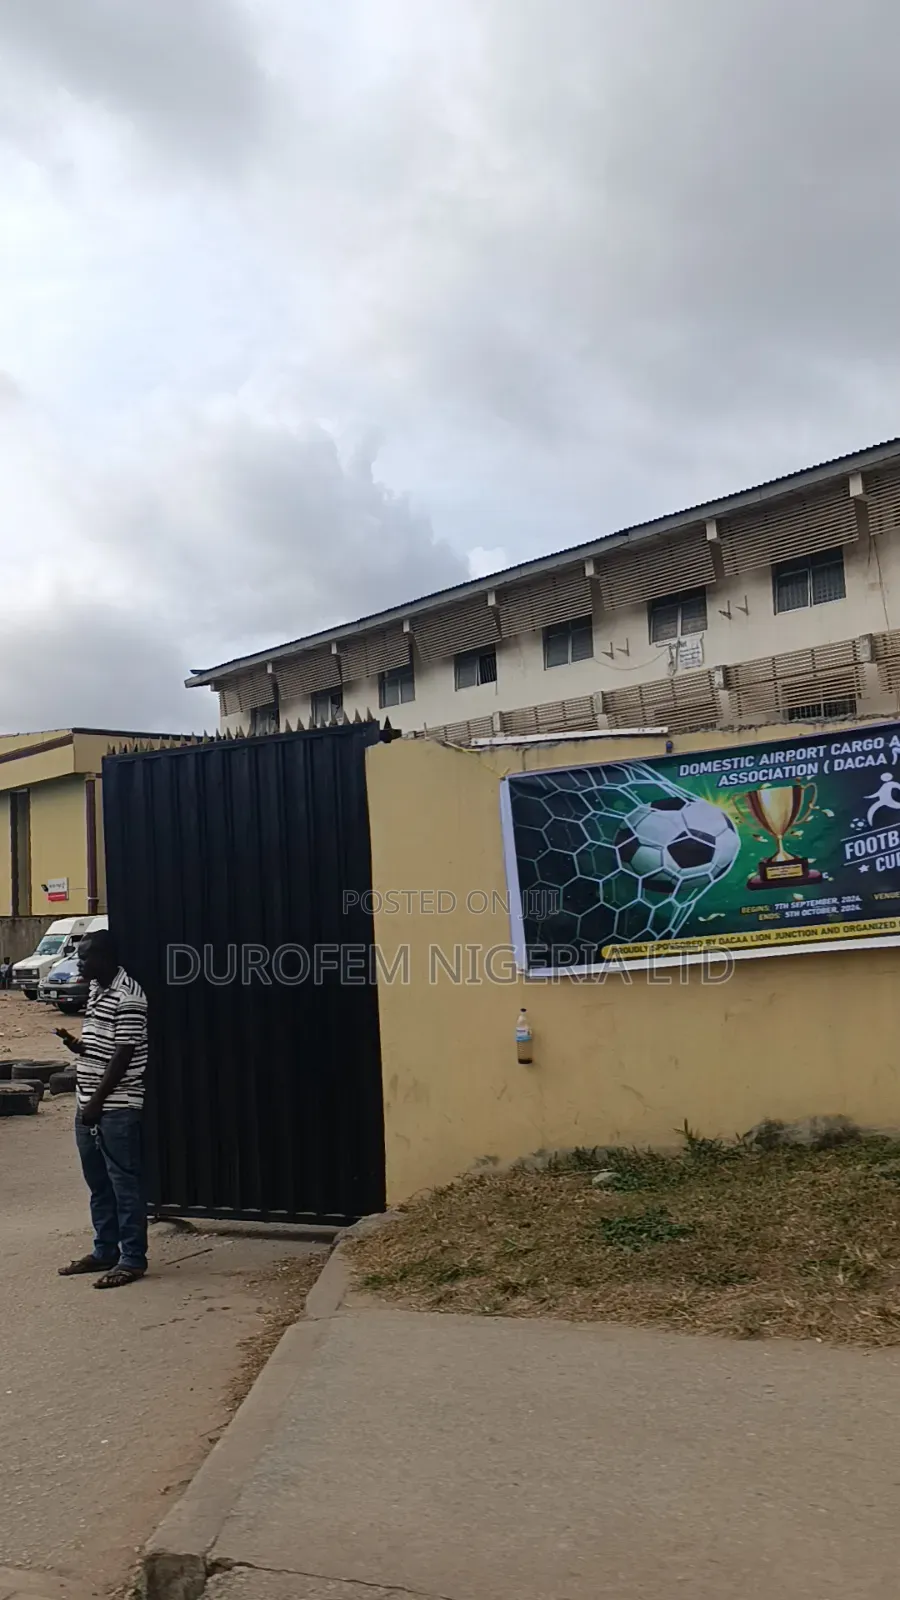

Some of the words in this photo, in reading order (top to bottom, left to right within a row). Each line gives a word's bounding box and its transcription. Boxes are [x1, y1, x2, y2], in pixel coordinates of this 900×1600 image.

[679, 755, 755, 777] DOMESTIC
[759, 745, 827, 766] AIRPORT
[830, 737, 885, 756] CARGO
[718, 762, 819, 787] ASSOCIATION
[833, 752, 888, 771] DACAA
[844, 830, 900, 860] FOOTB
[774, 902, 790, 910] 7TH
[784, 910, 801, 918] 5TH
[611, 944, 649, 955] PROUDLY
[650, 939, 704, 952] SPONSORED
[706, 937, 717, 946] BY
[719, 934, 749, 944] DACAA
[750, 933, 772, 943] LION
[774, 927, 818, 940] JUNCTION
[821, 925, 841, 935] AND
[842, 920, 897, 933] ORGANIZED
